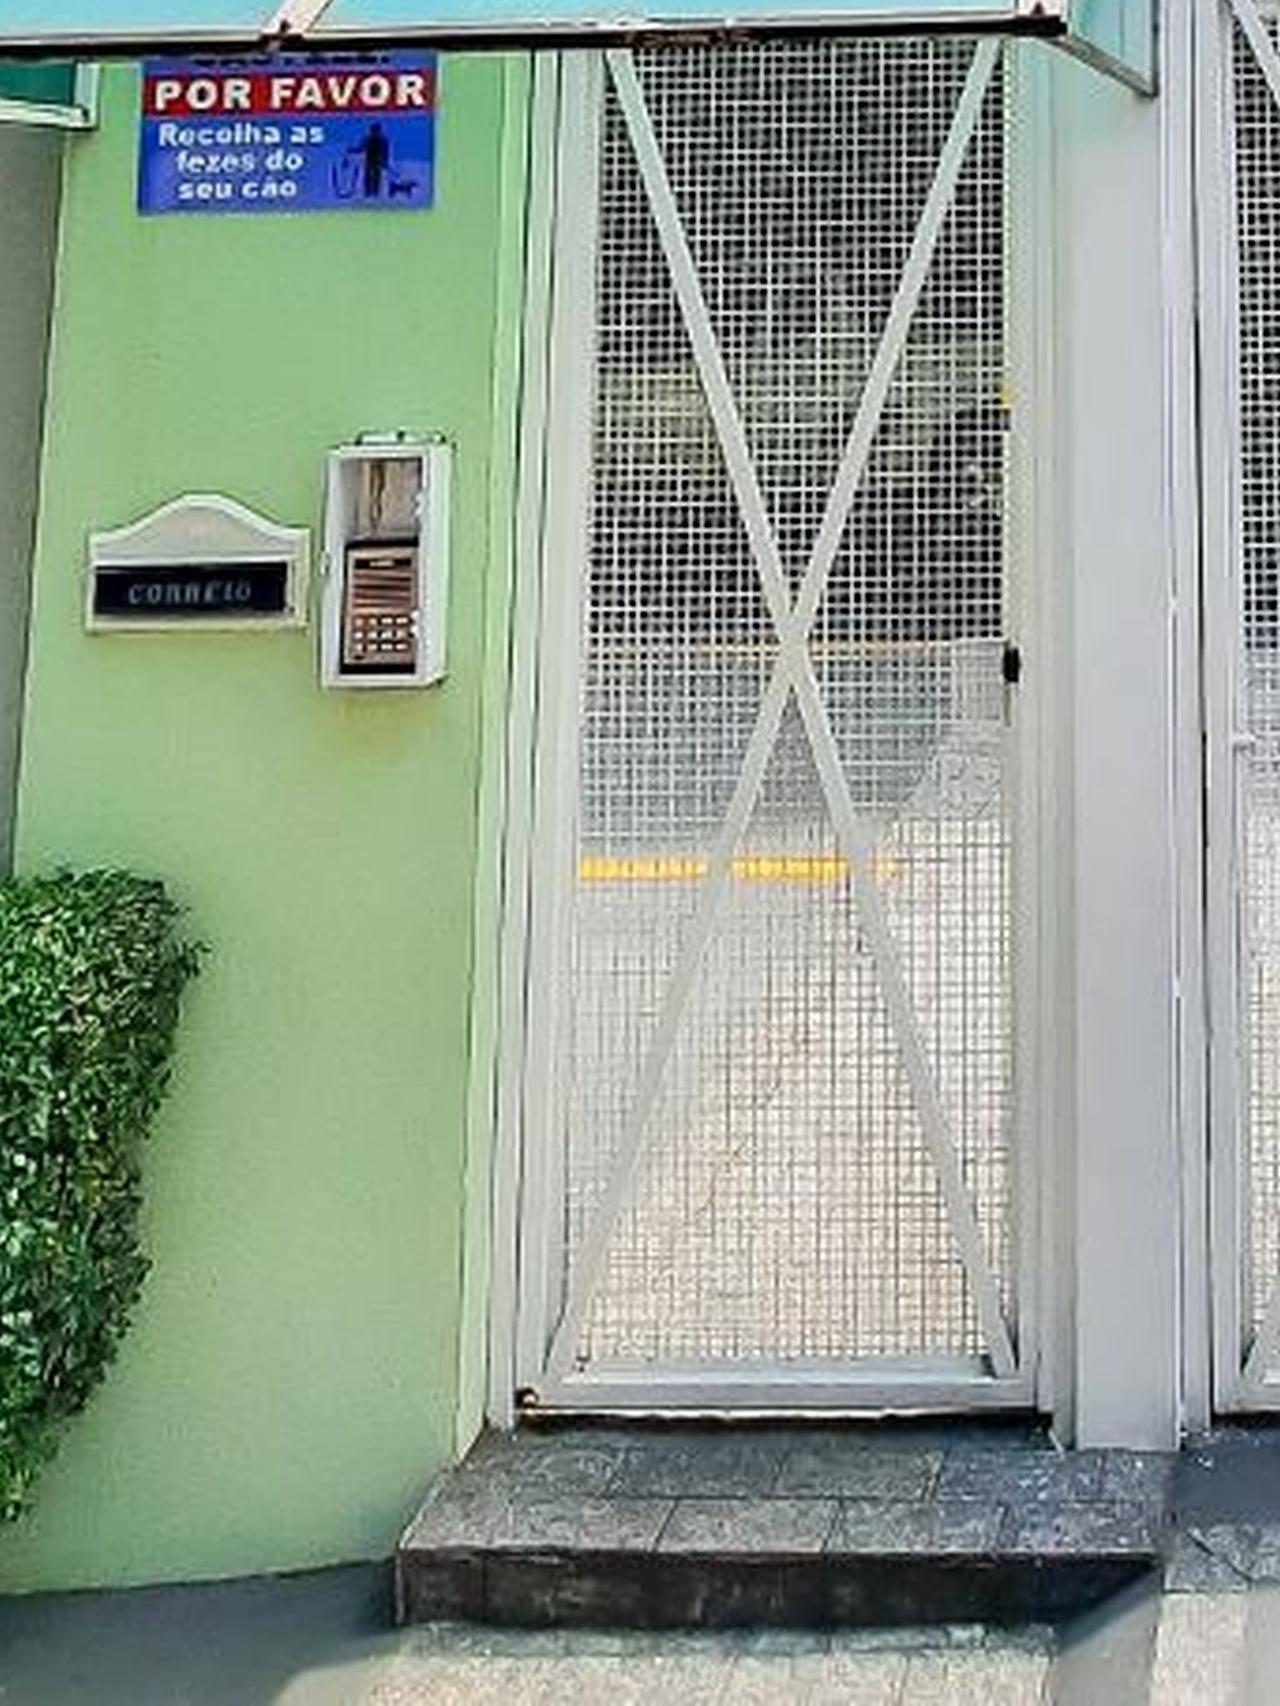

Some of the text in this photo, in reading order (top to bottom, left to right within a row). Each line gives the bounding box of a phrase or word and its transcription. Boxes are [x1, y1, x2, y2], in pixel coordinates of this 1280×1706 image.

[154, 73, 426, 111] POR FAVOR
[158, 122, 325, 147] Recolha as
[175, 150, 304, 174] fezes do
[177, 180, 233, 201] seu
